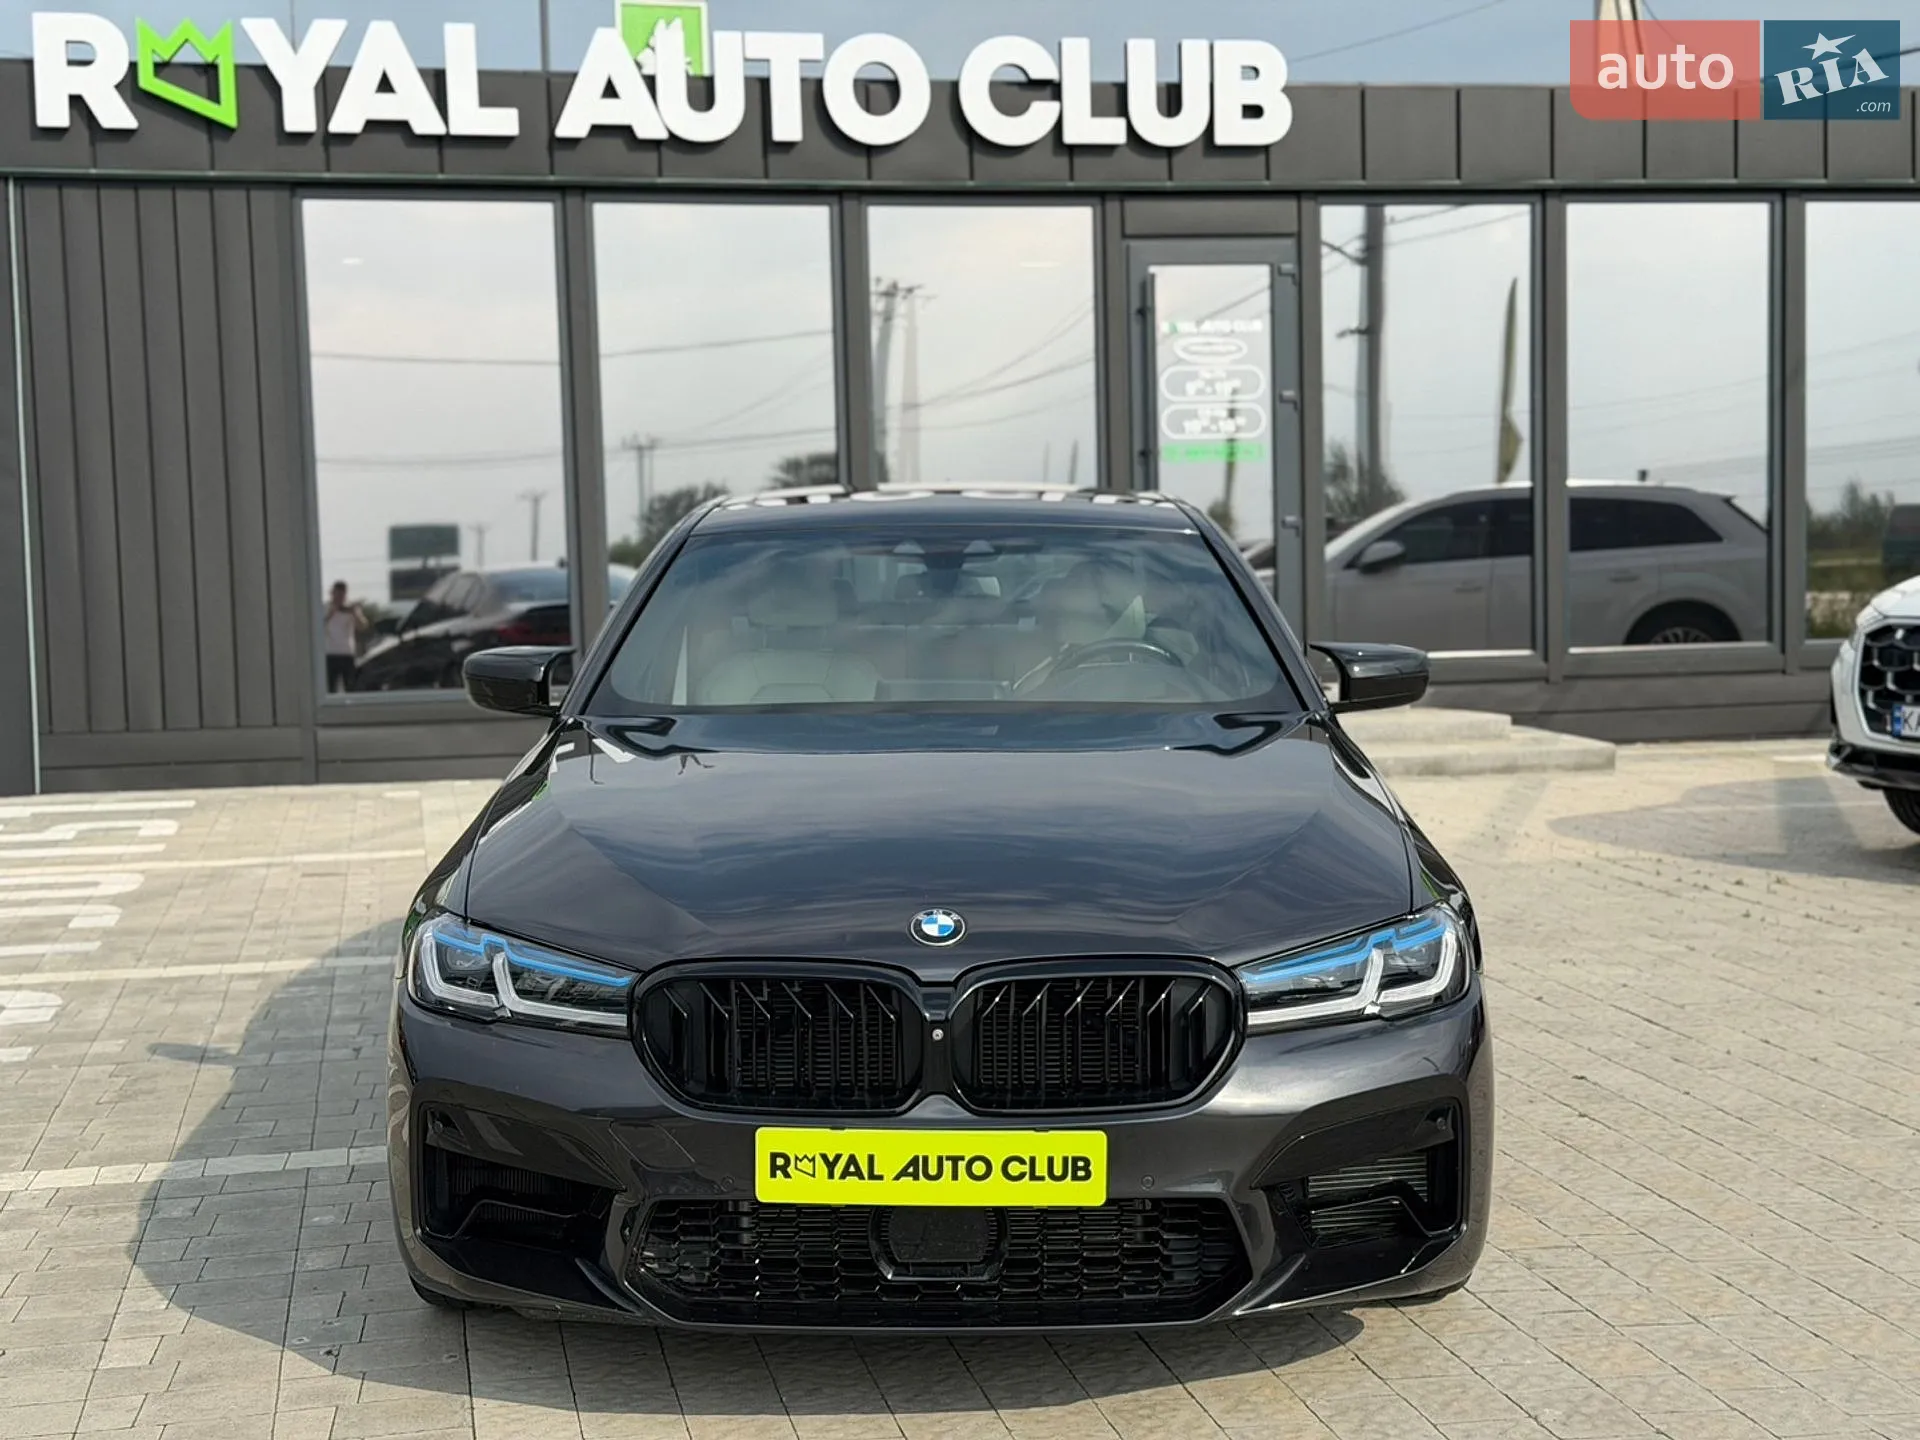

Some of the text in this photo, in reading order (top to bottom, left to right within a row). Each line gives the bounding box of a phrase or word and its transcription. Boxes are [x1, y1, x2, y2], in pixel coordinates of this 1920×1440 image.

[555, 28, 931, 146] AUTO
[959, 35, 1293, 147] CLUB
[893, 1155, 993, 1182] AUTO
[1002, 1156, 1092, 1182] CLUB
